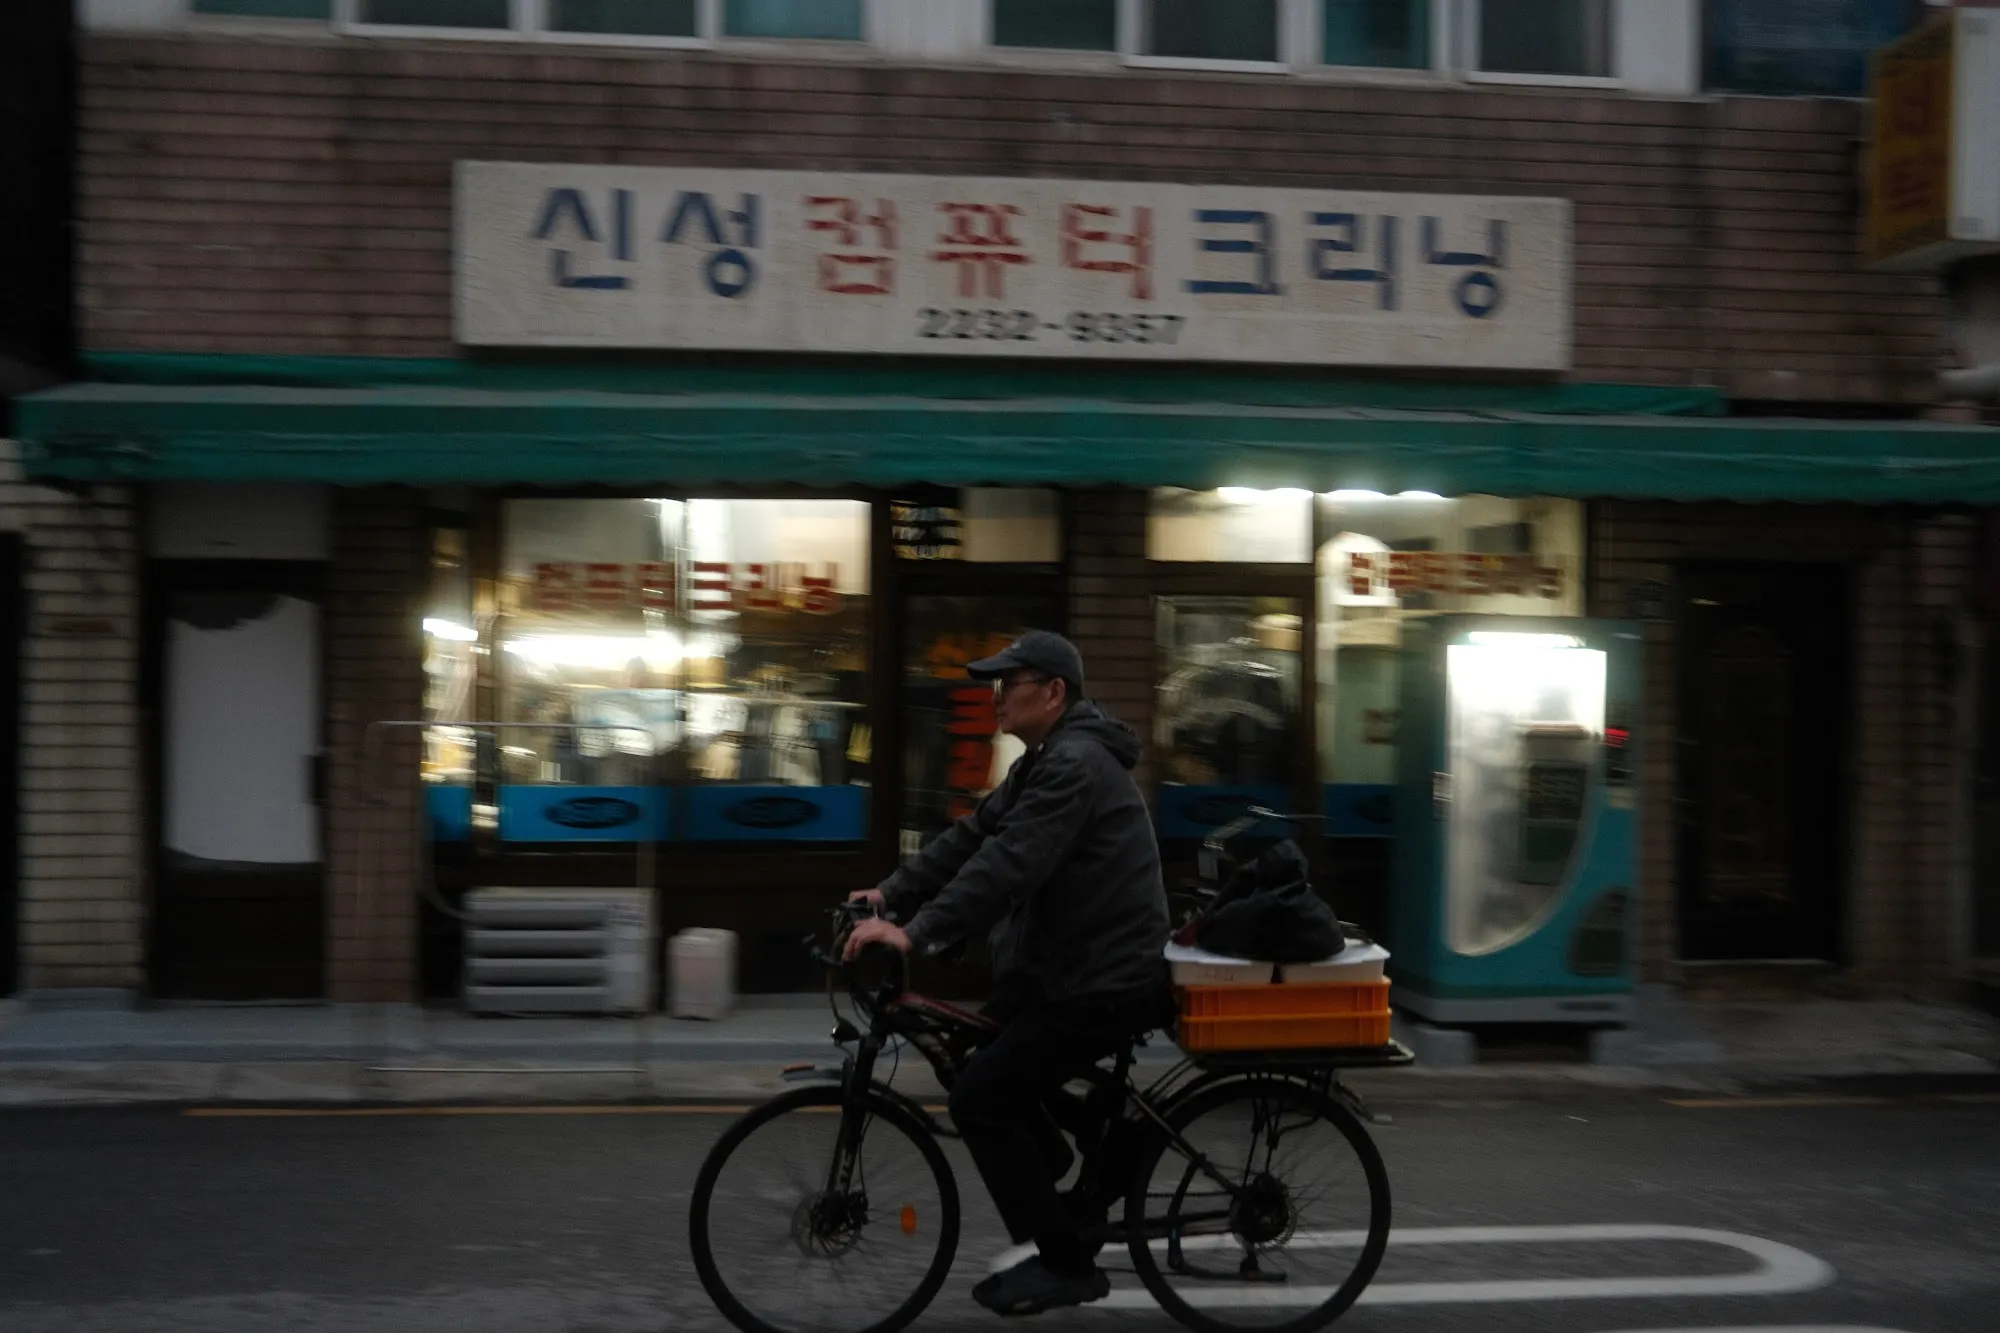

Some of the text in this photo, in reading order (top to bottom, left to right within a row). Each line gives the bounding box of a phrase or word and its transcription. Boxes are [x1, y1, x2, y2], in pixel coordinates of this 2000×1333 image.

[531, 187, 1507, 318] 신성 컴퓨터 크리닝
